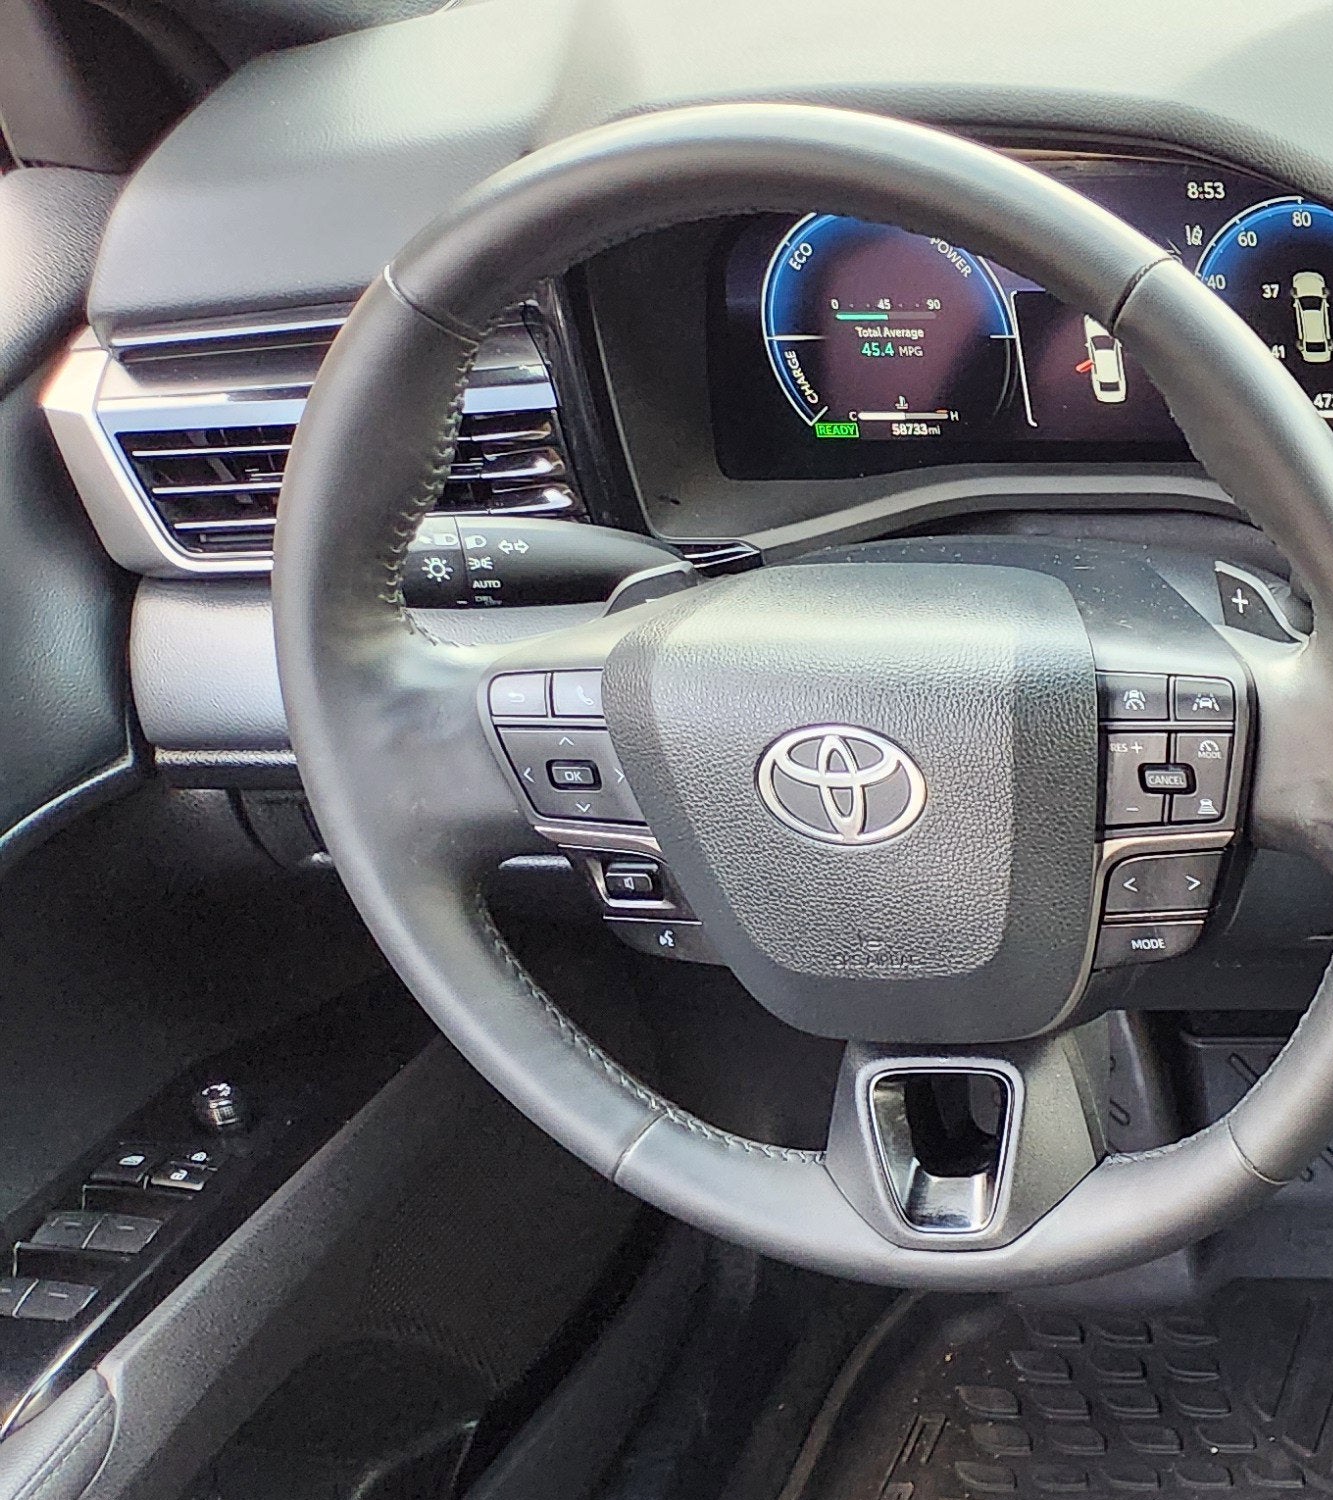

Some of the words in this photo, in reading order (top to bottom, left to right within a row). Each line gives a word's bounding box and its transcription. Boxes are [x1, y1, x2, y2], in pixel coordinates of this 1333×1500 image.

[1187, 182, 1225, 199] 8:53
[1292, 212, 1312, 227] 80
[1237, 231, 1257, 247] 60
[788, 242, 813, 271] ECO
[1207, 274, 1226, 290] 40
[1262, 284, 1280, 298] 37
[831, 299, 839, 310] 0
[877, 299, 891, 310] 45
[926, 299, 941, 310] 90
[855, 326, 882, 338] Total
[883, 327, 924, 340] Average
[861, 342, 894, 357] 45.4
[899, 346, 923, 357] MPG
[784, 350, 819, 405] CHARGE
[849, 412, 858, 421] C
[951, 412, 959, 421] H
[818, 425, 855, 435] READY
[473, 580, 501, 589] AUTO
[1110, 742, 1128, 752] RES
[1198, 751, 1222, 759] MODE
[564, 771, 582, 781] OK
[1148, 775, 1185, 785] CANCEL
[1131, 938, 1166, 949] MODE
